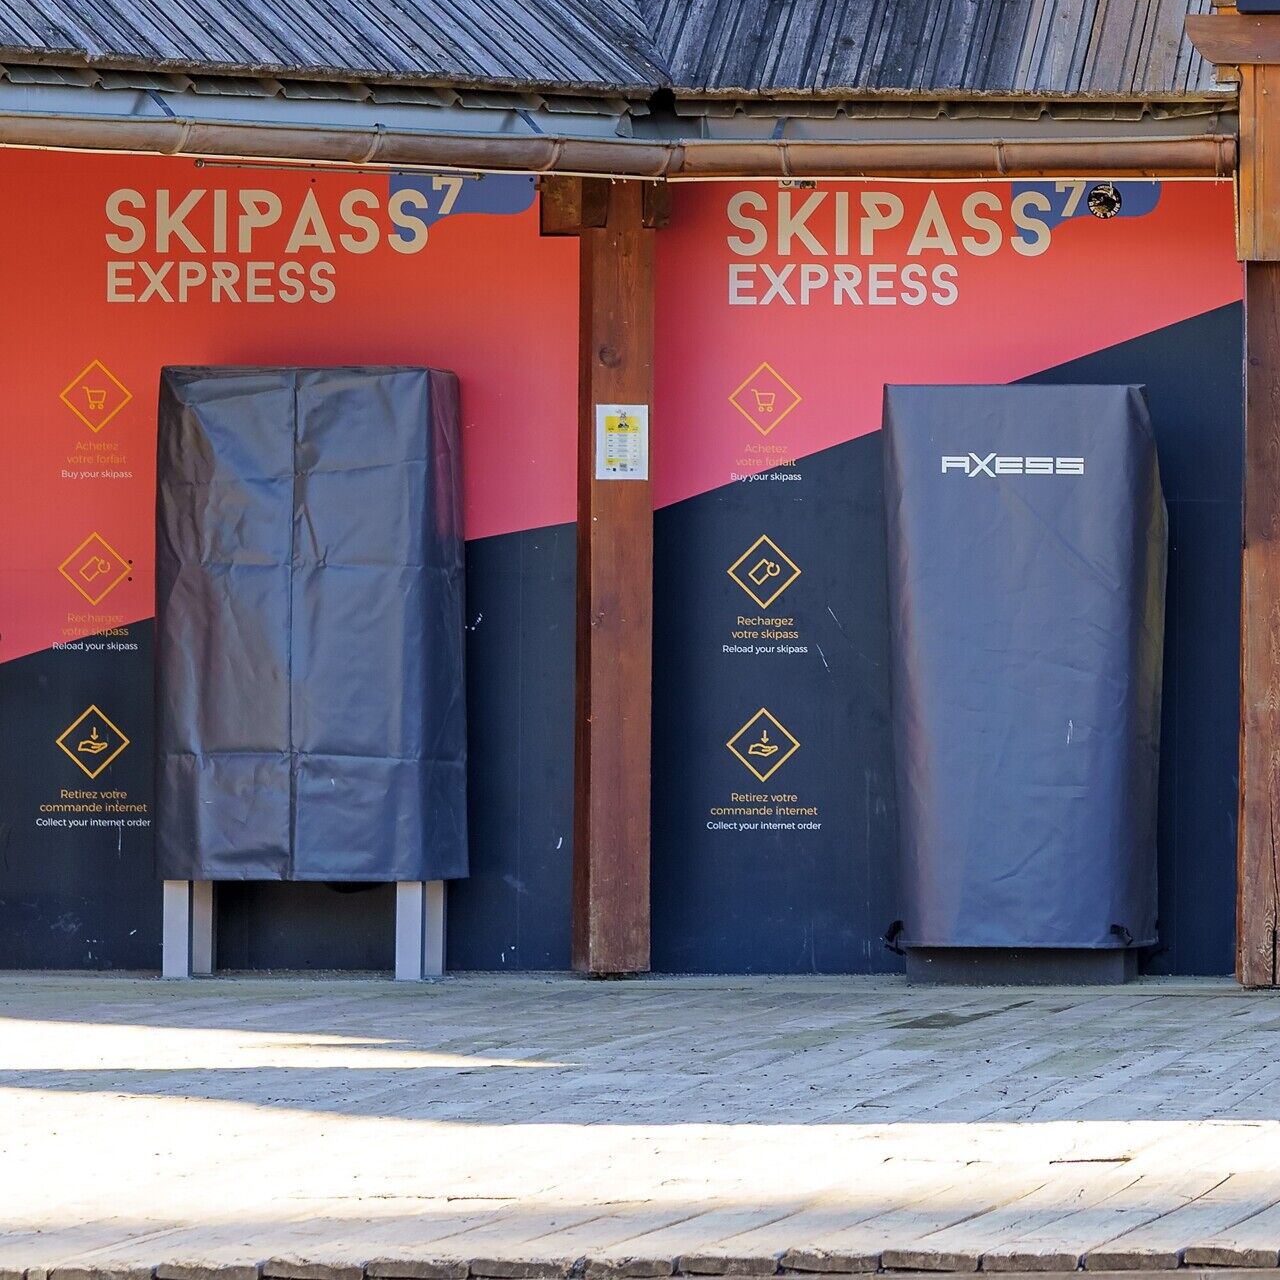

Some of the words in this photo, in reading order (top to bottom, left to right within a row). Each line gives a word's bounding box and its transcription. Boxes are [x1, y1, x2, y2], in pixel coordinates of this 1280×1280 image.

[105, 187, 428, 254] SKIPASS
[726, 191, 1052, 257] SKIPASS
[106, 260, 336, 304] EXPRESS
[728, 264, 958, 306] EXPRESS
[744, 444, 788, 453] Achetez
[735, 458, 762, 466] votre
[765, 457, 796, 466] forfait
[941, 452, 1085, 477] AXESS
[61, 470, 78, 480] Buy
[79, 472, 99, 480] your
[101, 470, 133, 480] skipass
[730, 473, 748, 482] Buy
[748, 474, 768, 482] your
[770, 473, 802, 482] skipass
[737, 616, 794, 627] Rechargez
[92, 627, 129, 637] skipass
[731, 630, 759, 639] votre
[761, 629, 799, 640] skipass
[52, 642, 83, 650] Reload
[85, 643, 105, 651] your
[106, 642, 138, 651] skipass
[722, 645, 753, 653] Reload
[755, 646, 774, 654] your
[776, 645, 808, 654] skipass
[60, 789, 97, 799] Retirez
[100, 790, 128, 799] votre
[731, 792, 768, 802] Retirez
[770, 793, 798, 802] votre
[40, 803, 102, 812] commande
[105, 803, 148, 812] internet
[710, 806, 773, 815] commande
[775, 806, 818, 815] internet
[36, 818, 67, 827] Collect
[68, 820, 88, 828] your
[90, 818, 125, 827] internet
[127, 818, 151, 827] order
[706, 821, 737, 830] Collect
[739, 823, 759, 831] your
[760, 821, 795, 830] internet
[797, 821, 822, 830] order
